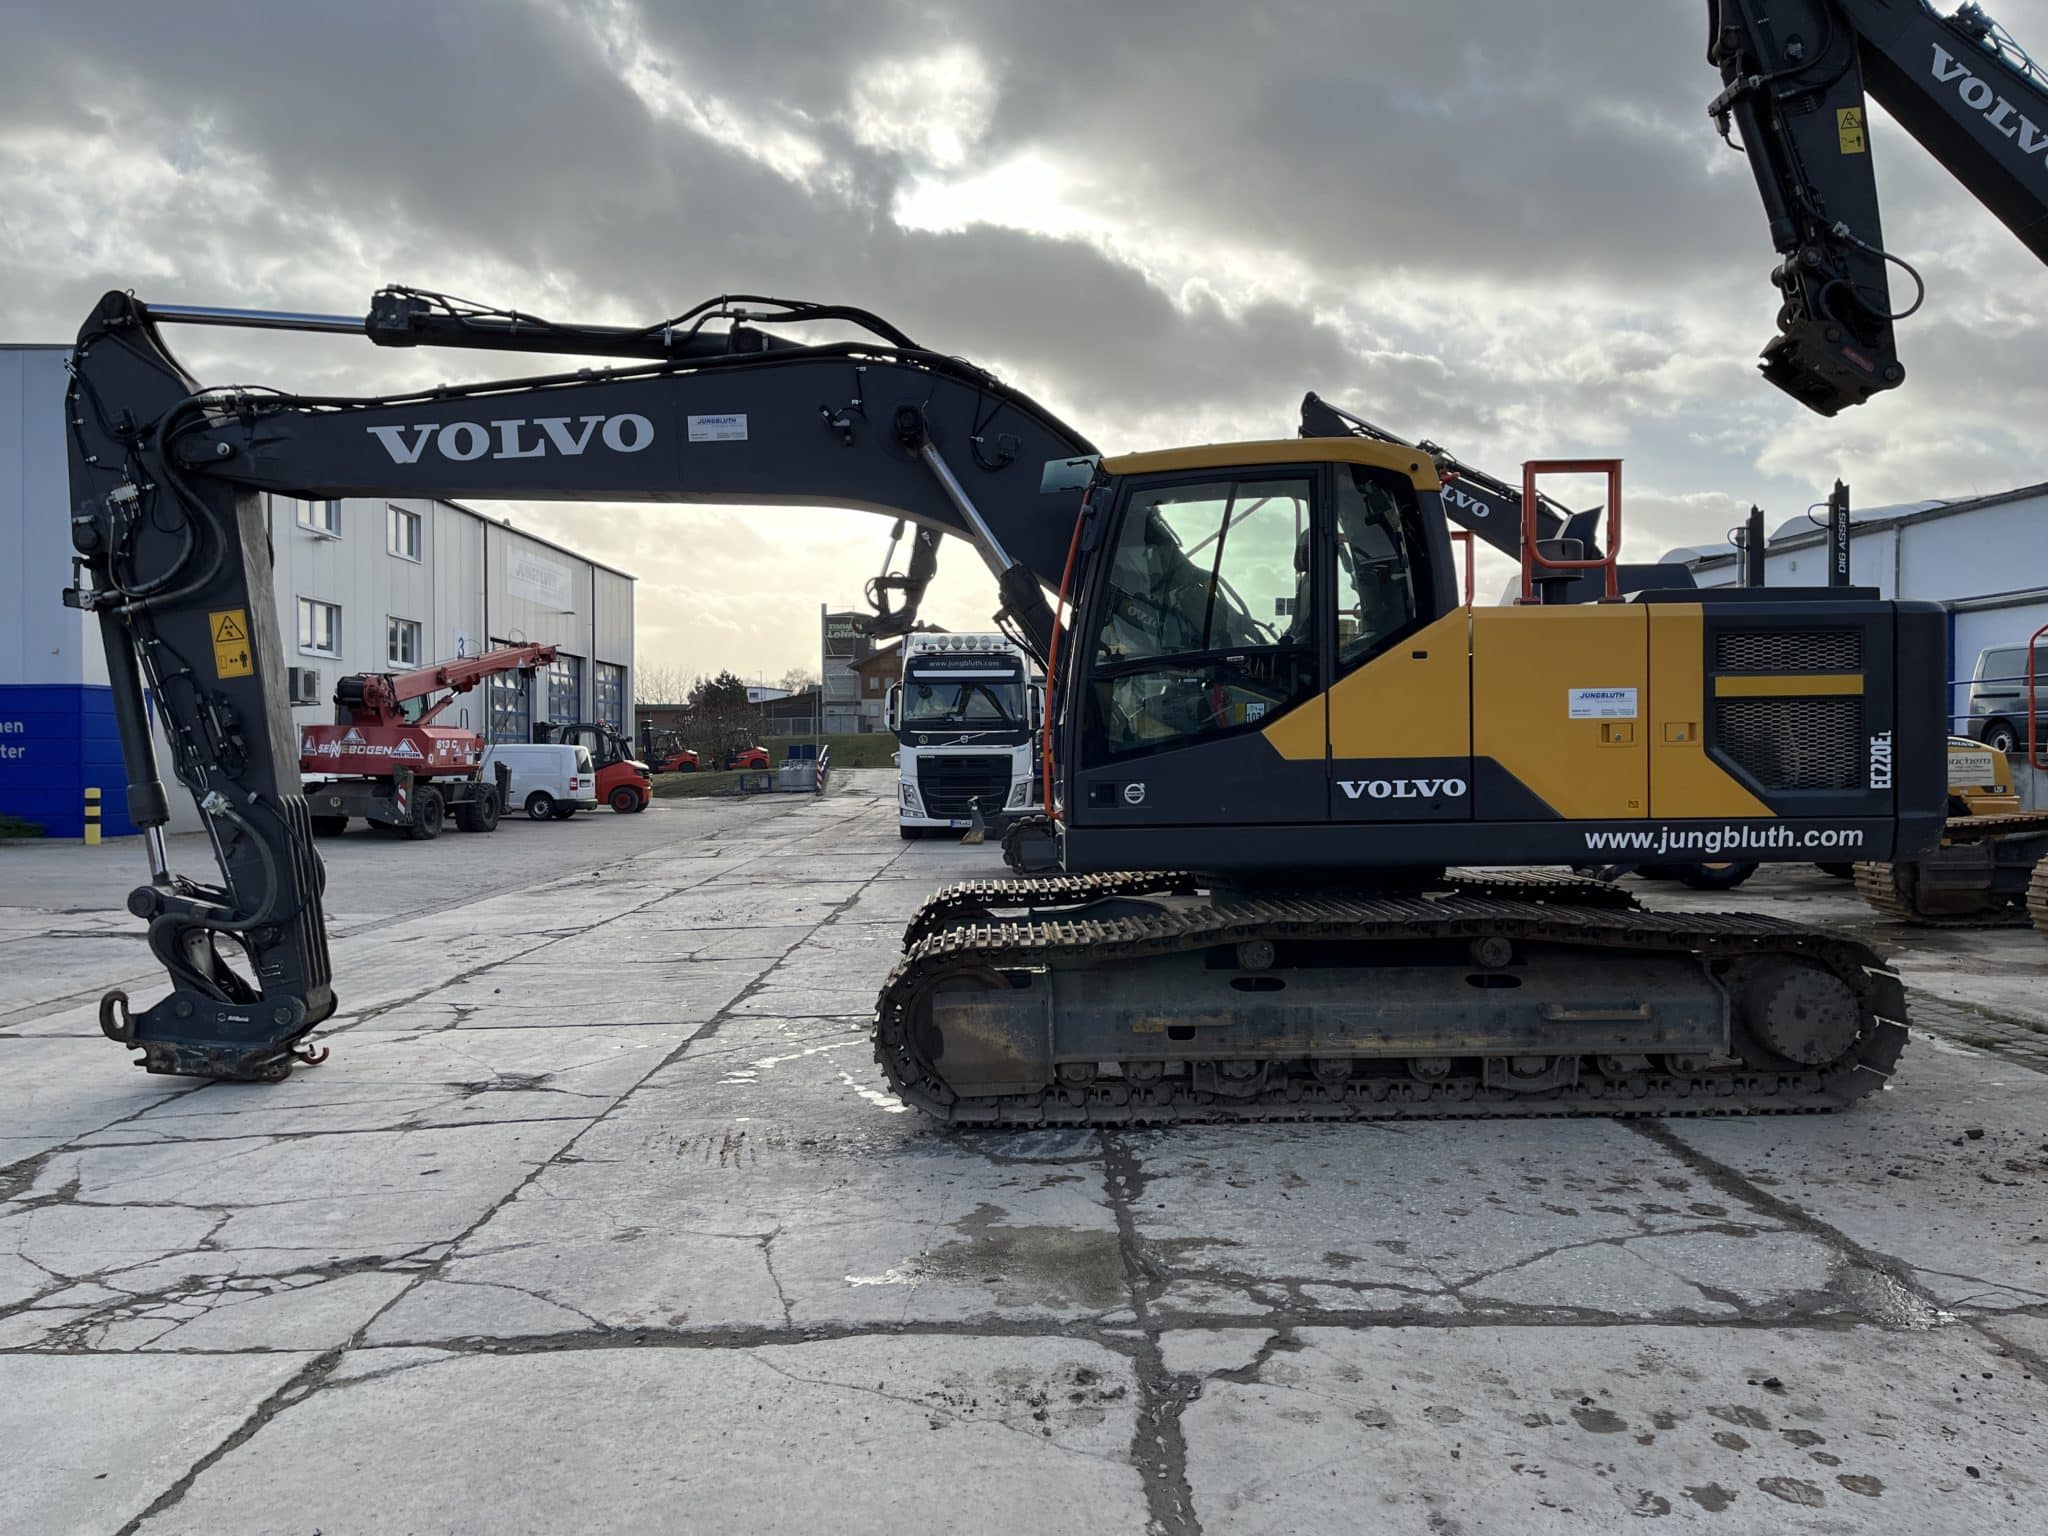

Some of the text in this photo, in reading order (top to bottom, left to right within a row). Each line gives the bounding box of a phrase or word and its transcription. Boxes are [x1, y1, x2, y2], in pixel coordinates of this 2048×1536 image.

[1931, 42, 2048, 170] VOLV
[366, 413, 655, 464] VOLVO
[1838, 504, 1847, 574] DIG ASSIST
[1580, 691, 1625, 699] JUNGBLUTH
[1336, 778, 1467, 799] VOLVO
[1584, 826, 1865, 854] www.jungbluth.com
